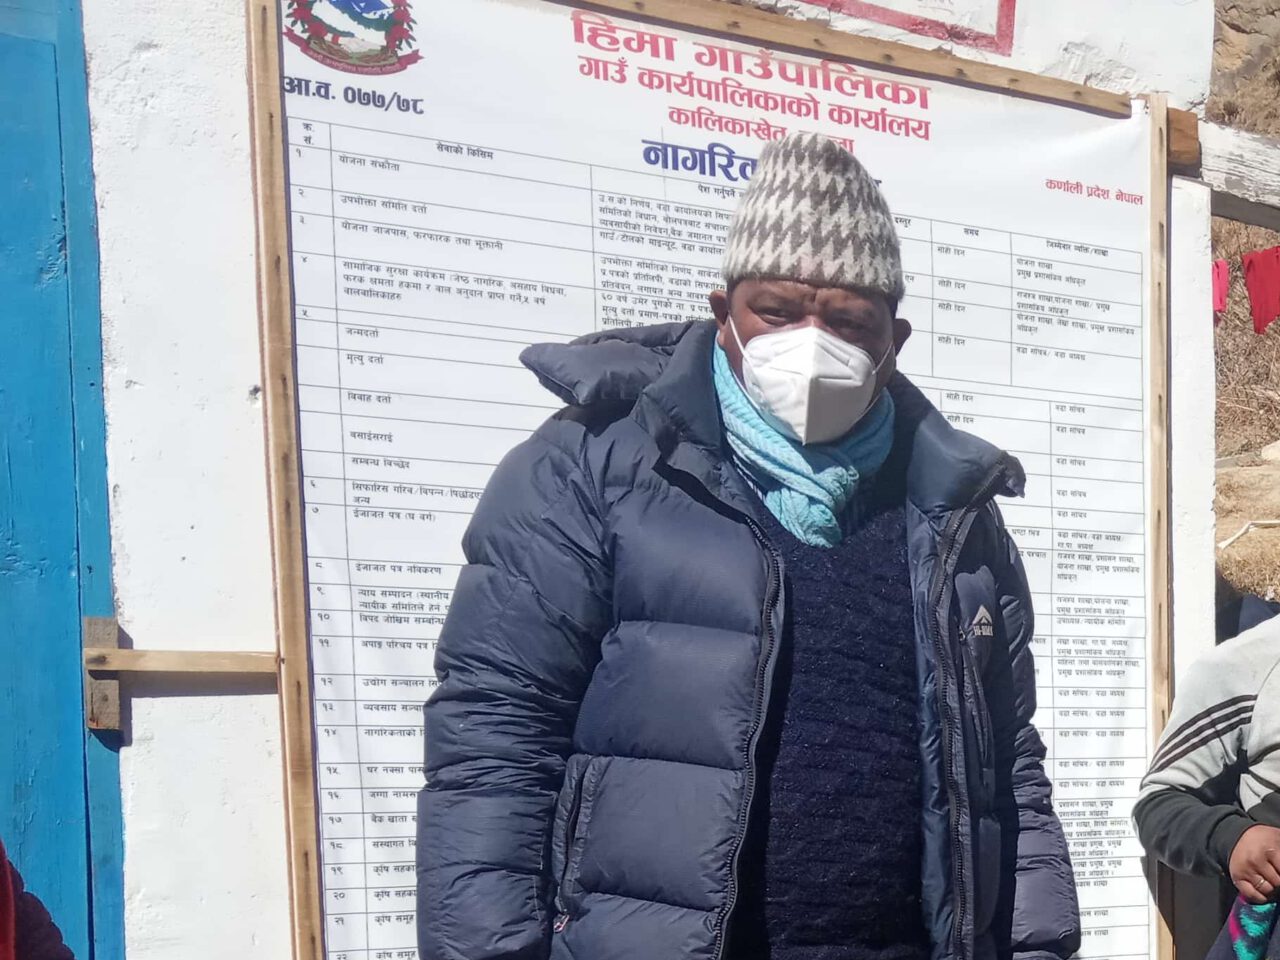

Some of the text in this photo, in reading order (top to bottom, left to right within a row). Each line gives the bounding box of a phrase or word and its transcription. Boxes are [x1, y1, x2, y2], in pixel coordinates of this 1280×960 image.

[343, 86, 424, 114] ०७७/७८
[571, 9, 932, 109] हिमा गाउँपालिका
[578, 56, 931, 141] गाउँ कार्यपालिकाको कार्यालय
